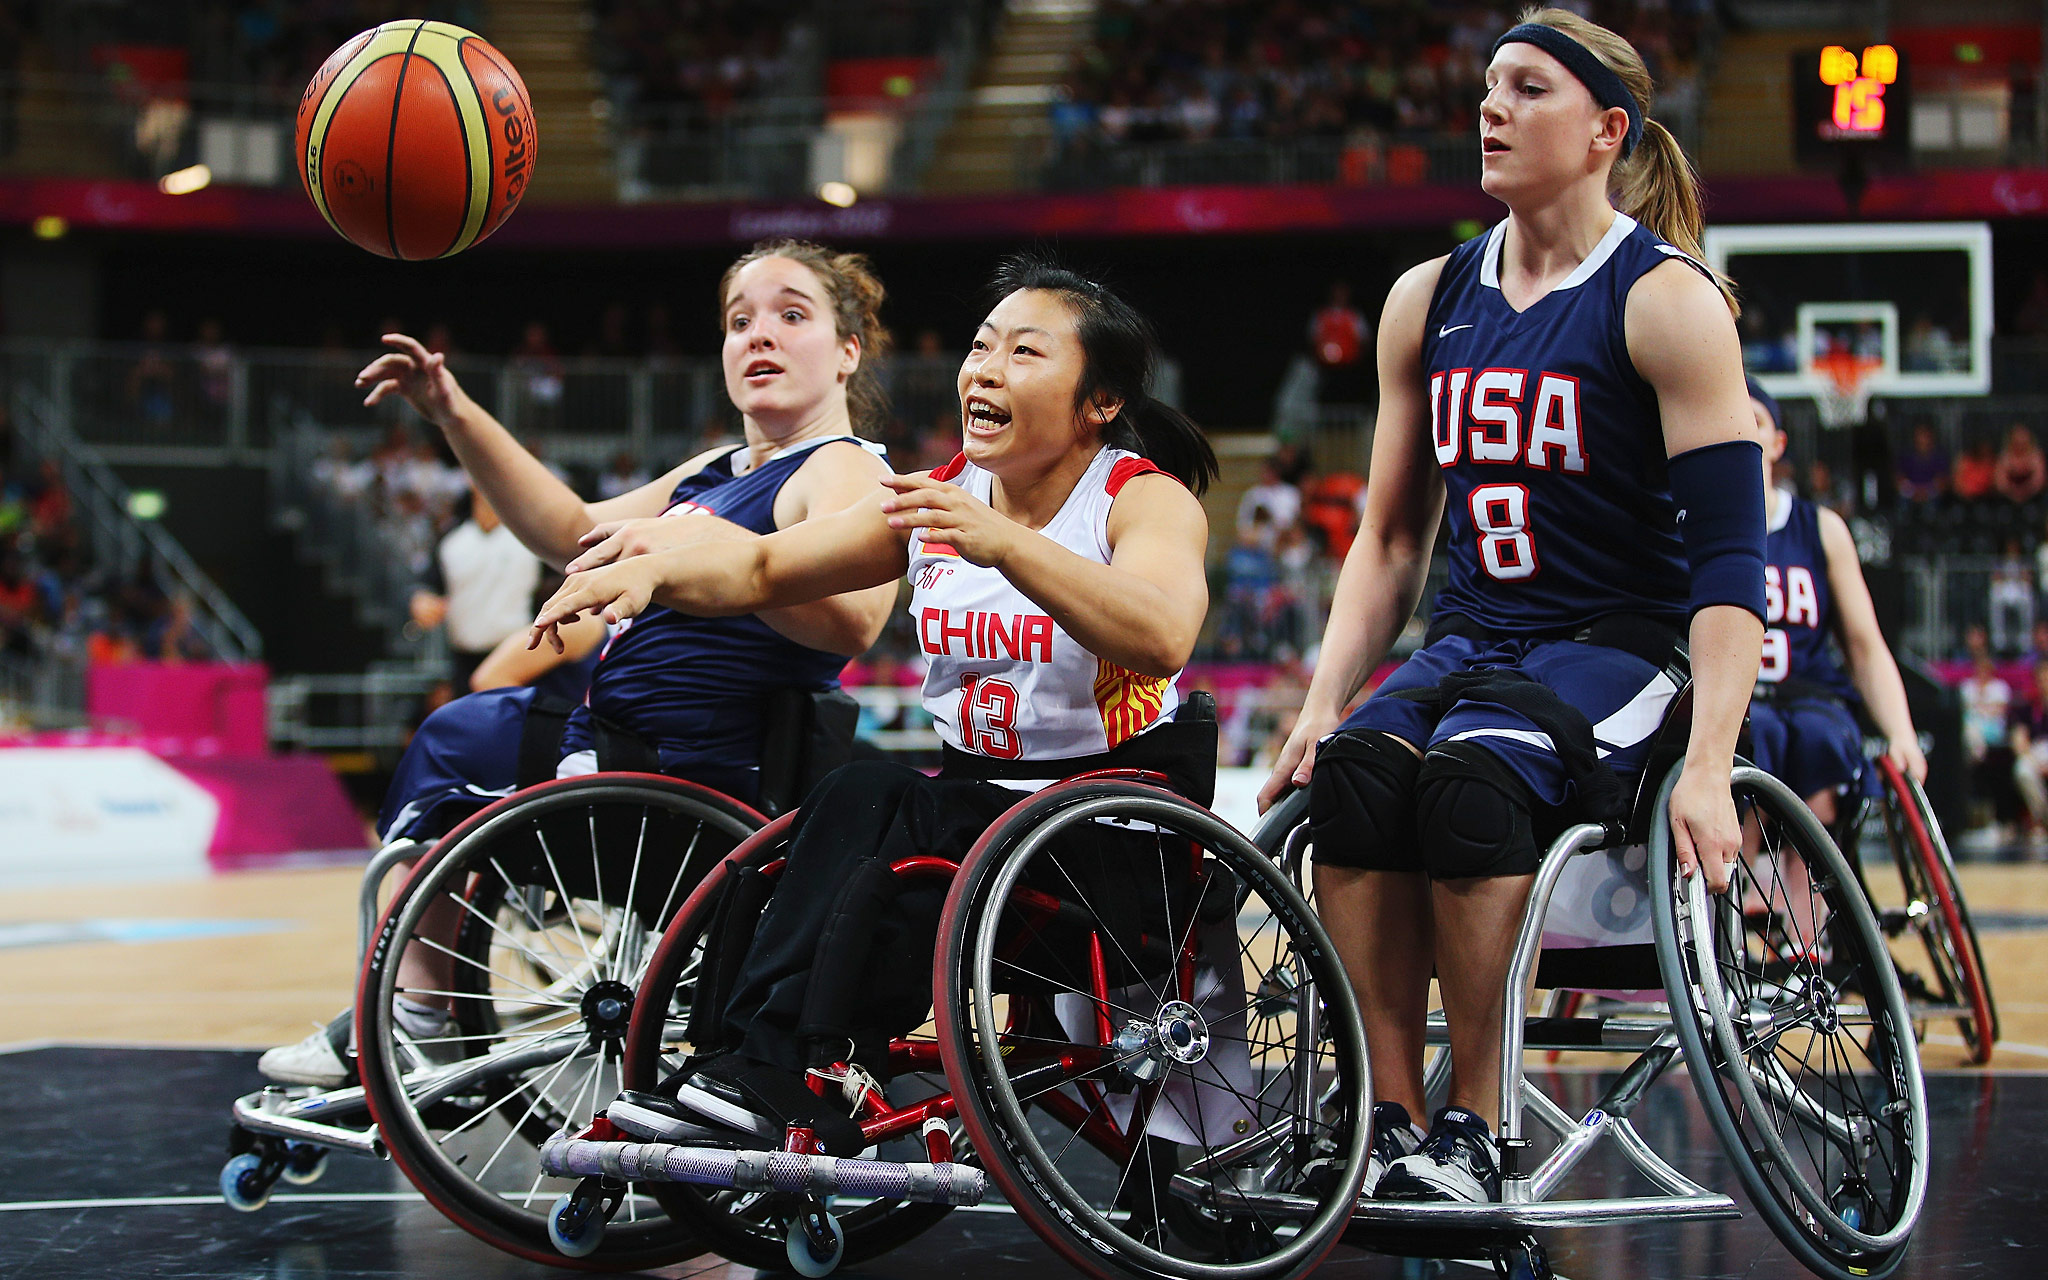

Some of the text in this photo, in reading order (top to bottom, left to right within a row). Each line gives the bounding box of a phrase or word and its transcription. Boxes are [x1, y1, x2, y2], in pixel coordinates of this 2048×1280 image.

[310, 144, 318, 186] GL6
[1430, 367, 1590, 477] USA
[1468, 482, 1541, 584] 8
[1764, 564, 1819, 630] SA
[921, 606, 1054, 664] CHINA
[957, 671, 1024, 761] 13
[371, 917, 397, 972] KENDA
[1443, 1110, 1469, 1123] NIKE
